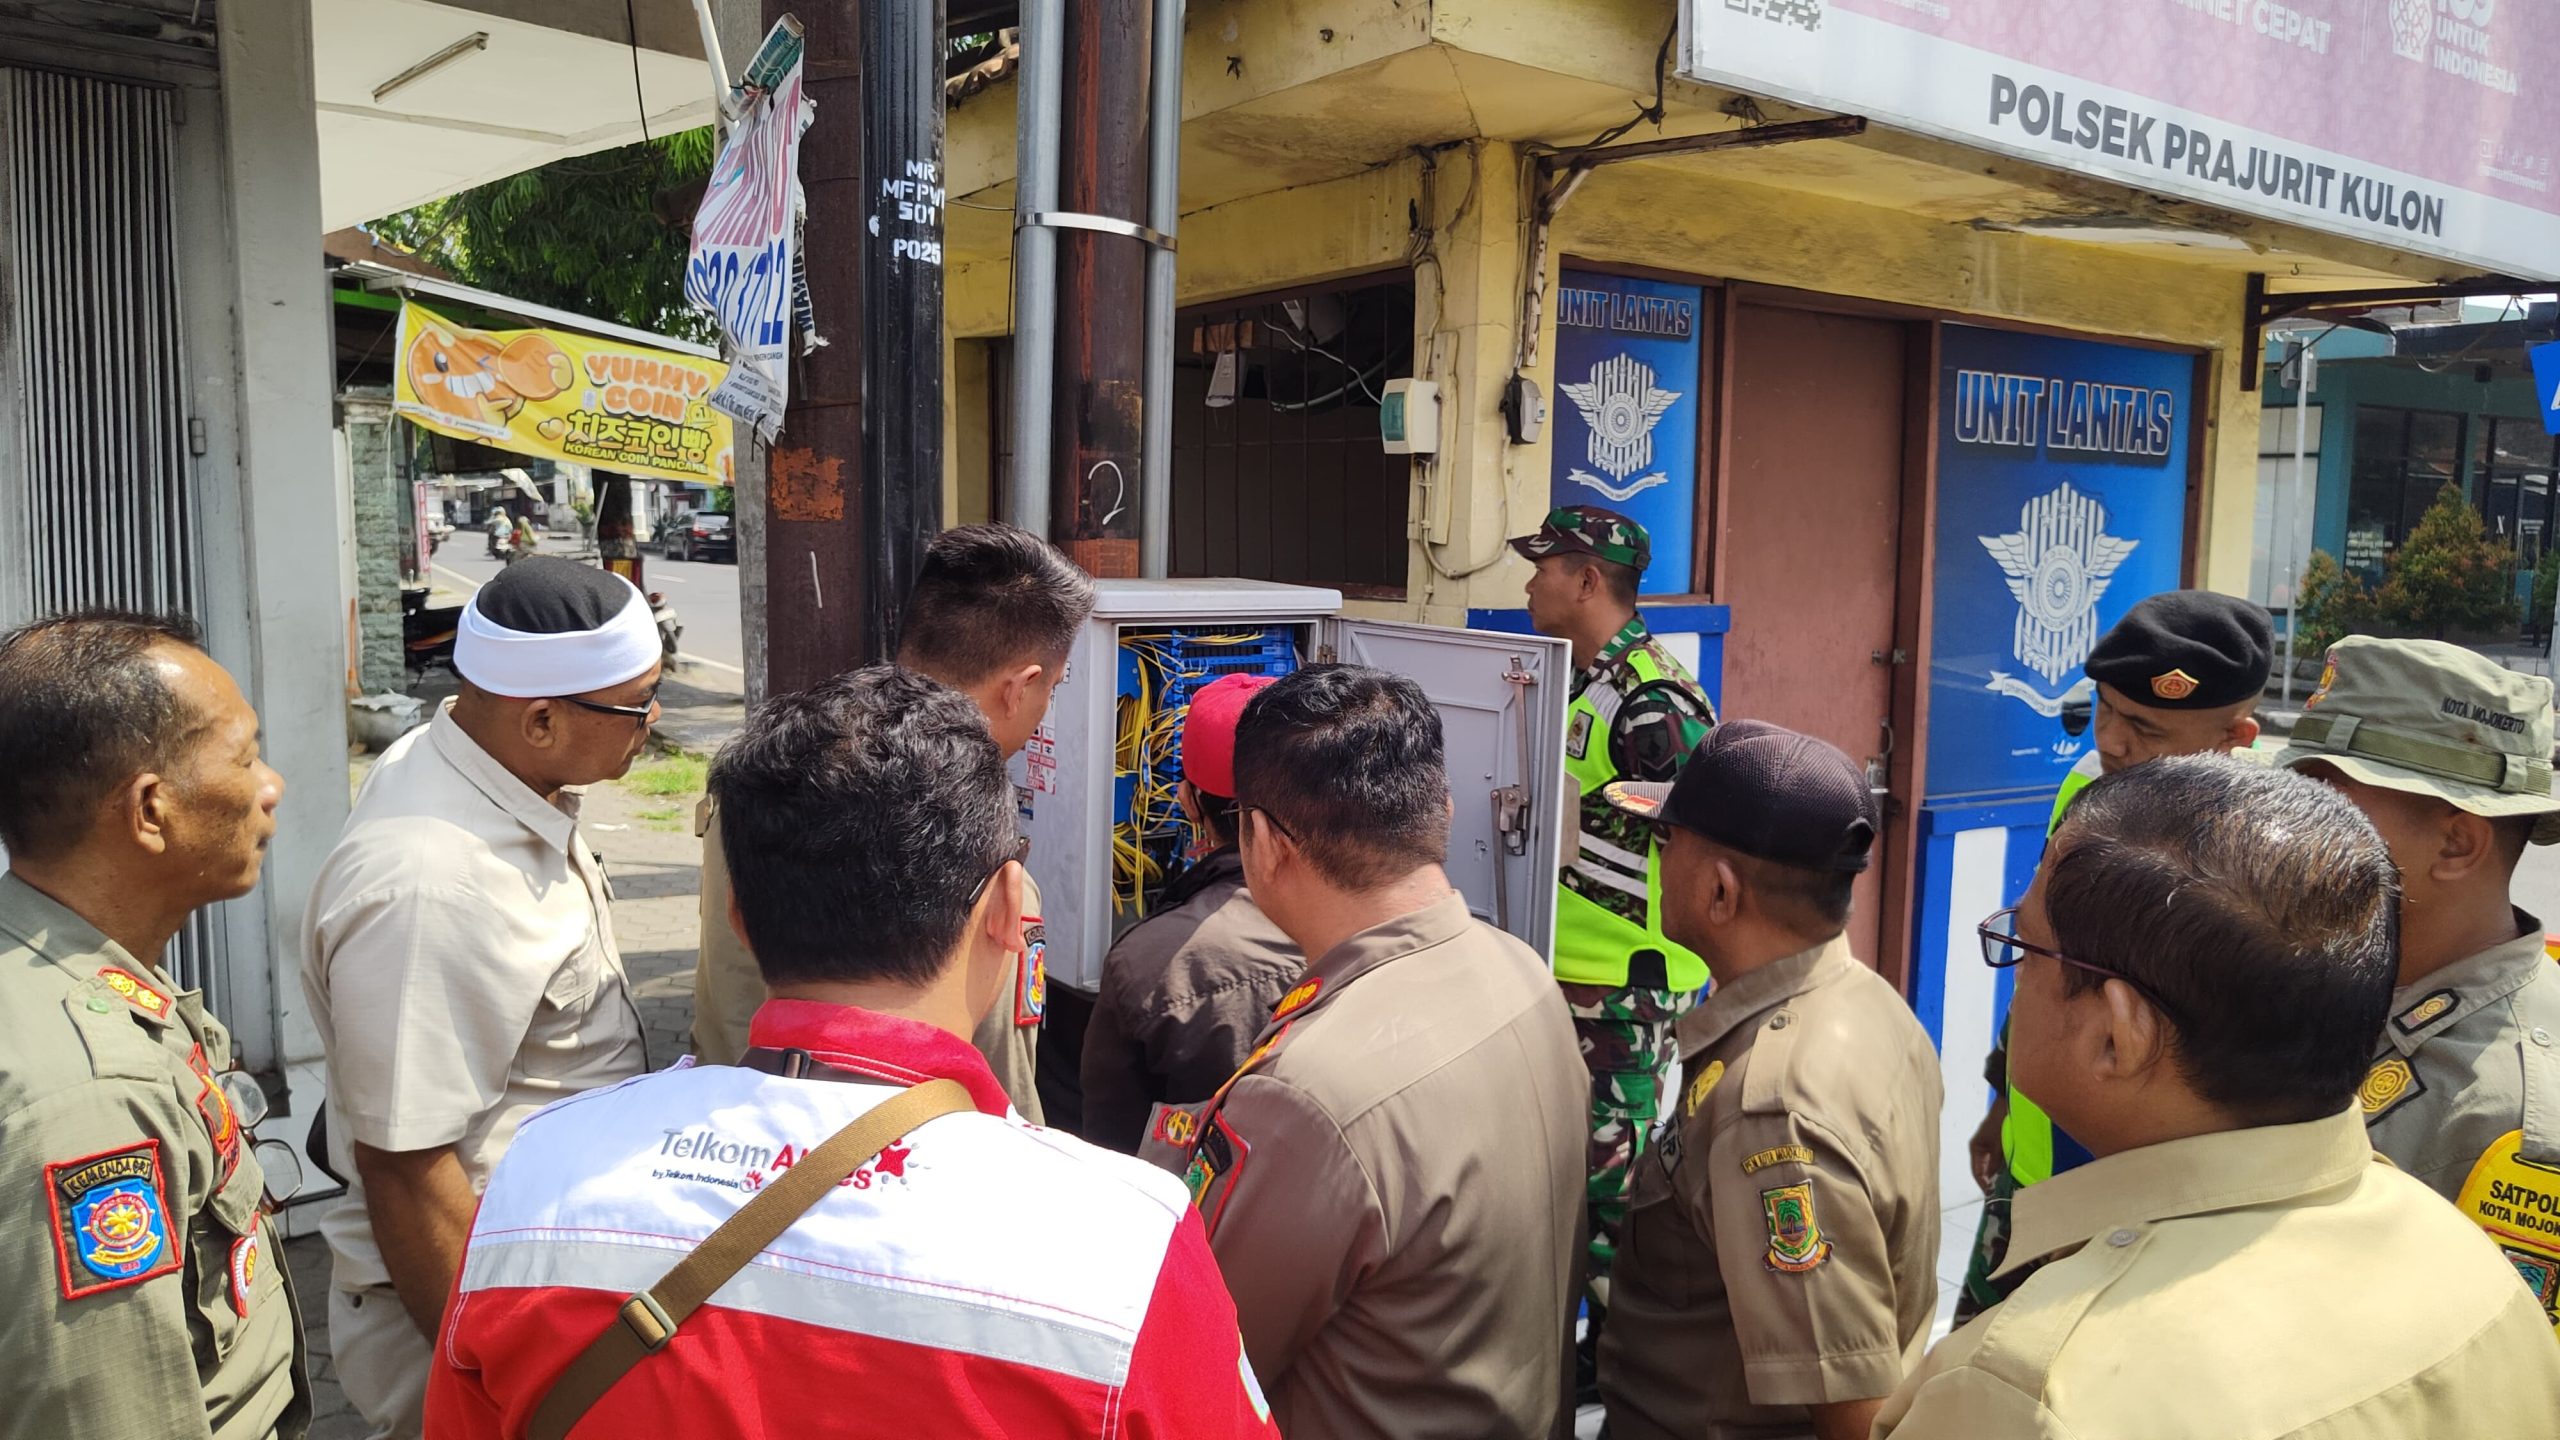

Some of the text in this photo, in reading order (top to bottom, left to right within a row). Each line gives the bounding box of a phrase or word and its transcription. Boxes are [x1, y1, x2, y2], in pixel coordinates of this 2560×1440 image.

[2252, 0, 2331, 55] CEPAT
[2435, 14, 2490, 57] UNTUK
[2433, 44, 2519, 96] INDONESIA
[906, 159, 935, 183] MR
[1989, 74, 2444, 238] POLSEK PRAJURIT KULON
[898, 201, 935, 227] 501
[893, 238, 941, 266] P025
[1556, 287, 1692, 337] UNIT LANTAS
[585, 353, 709, 398] YUMMY
[602, 383, 687, 423] COIN
[1955, 369, 2173, 457] UNIT LANTAS
[564, 442, 709, 475] KOREAN COIN PANCAKE
[2441, 696, 2525, 734] KOTA MOJOKERTO
[652, 1169, 739, 1189] by Telkom Indonesia
[2479, 1200, 2511, 1223] KOTA
